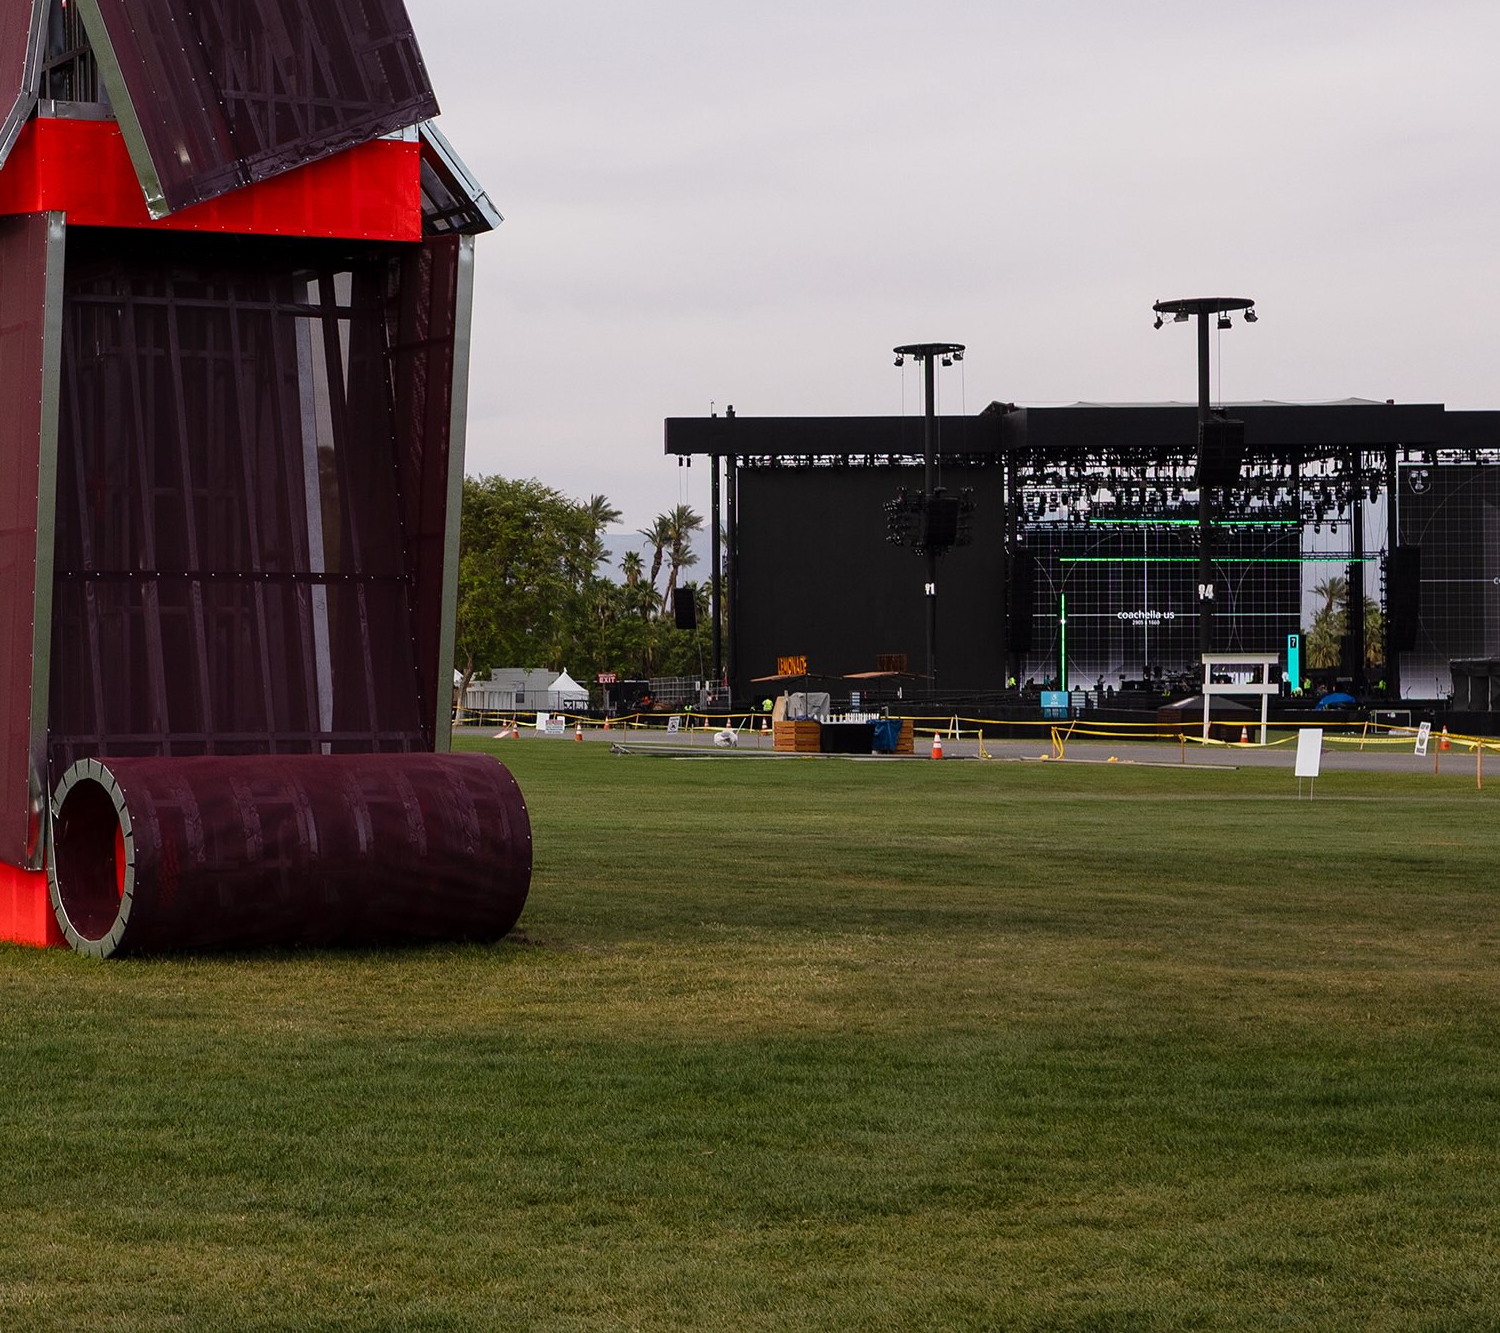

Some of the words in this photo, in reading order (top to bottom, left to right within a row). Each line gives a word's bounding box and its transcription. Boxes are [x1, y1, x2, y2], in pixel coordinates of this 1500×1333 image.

[1117, 610, 1161, 619] coachella
[1163, 611, 1175, 619] us
[1291, 638, 1296, 647] 7
